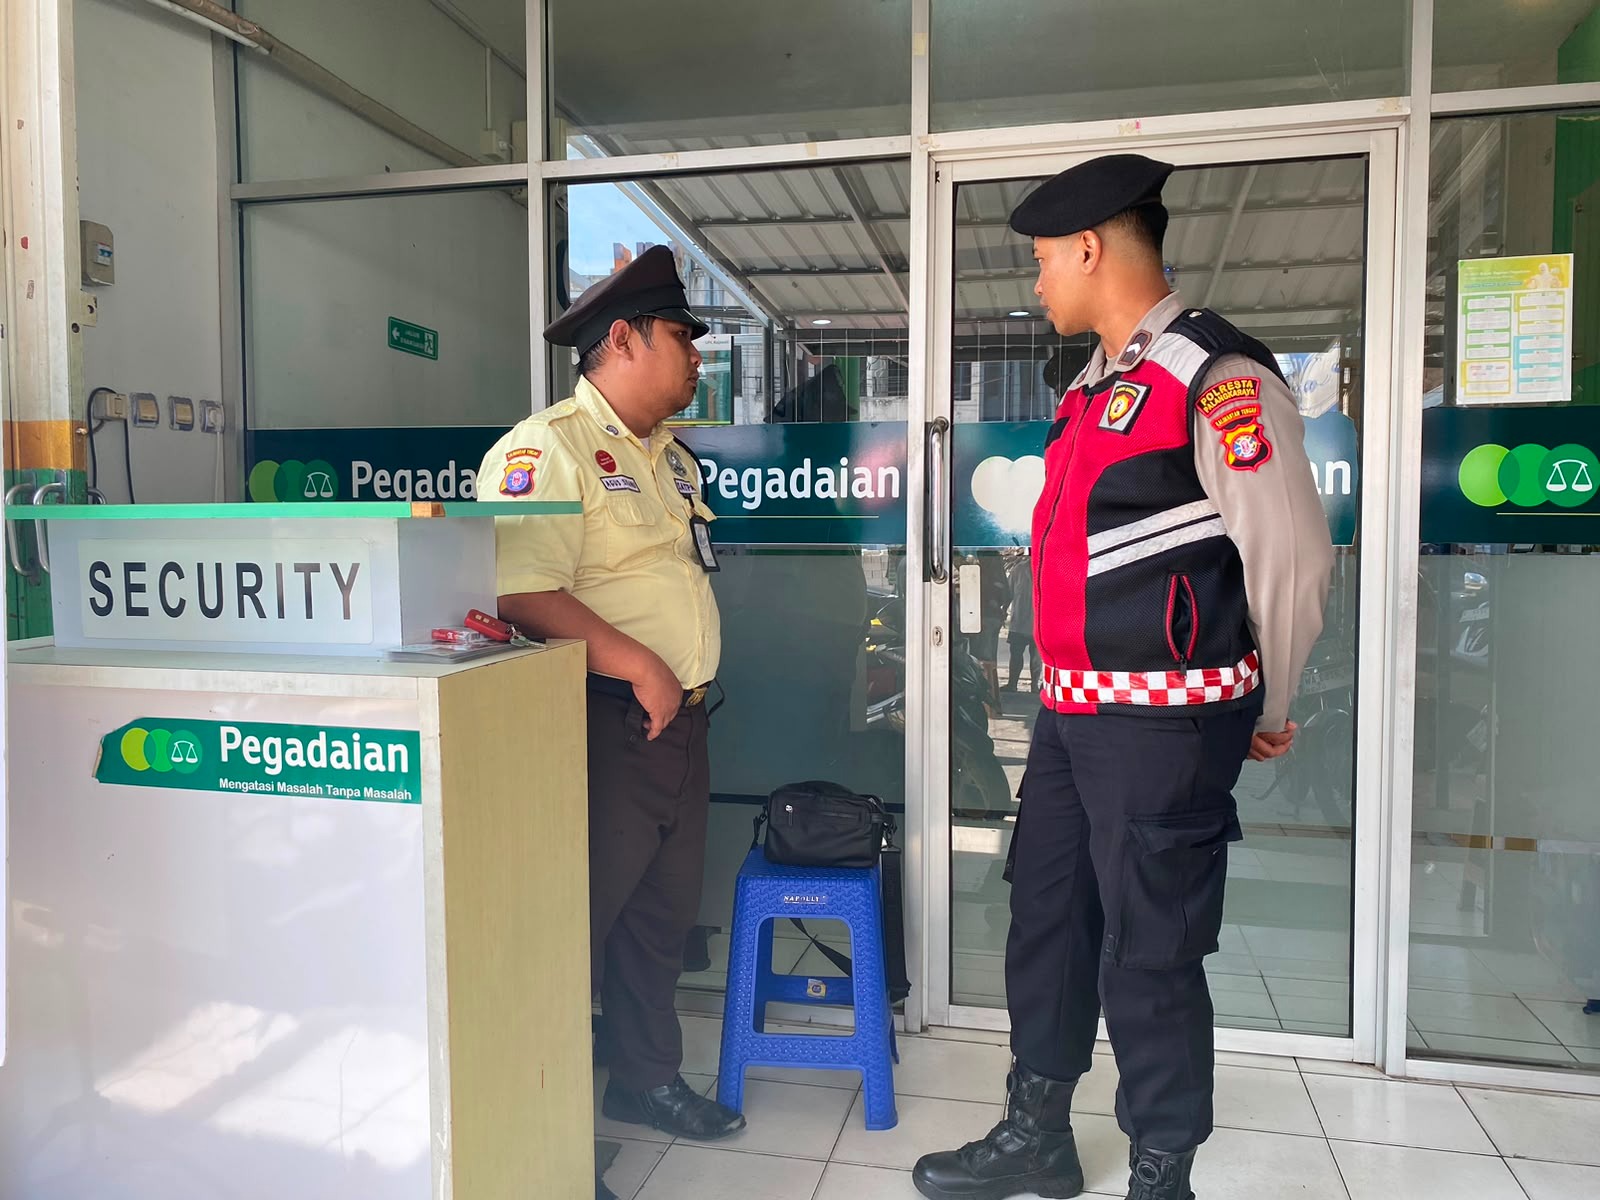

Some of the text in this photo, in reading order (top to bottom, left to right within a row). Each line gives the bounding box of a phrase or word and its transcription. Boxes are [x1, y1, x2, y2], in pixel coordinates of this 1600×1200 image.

[1200, 380, 1253, 406] POLRESTA
[697, 456, 900, 511] Pegadaian
[88, 560, 361, 620] SECURITY
[219, 725, 409, 775] Pegadaian
[219, 777, 412, 801] Mengatasi Masalah Tanpa Masalah
